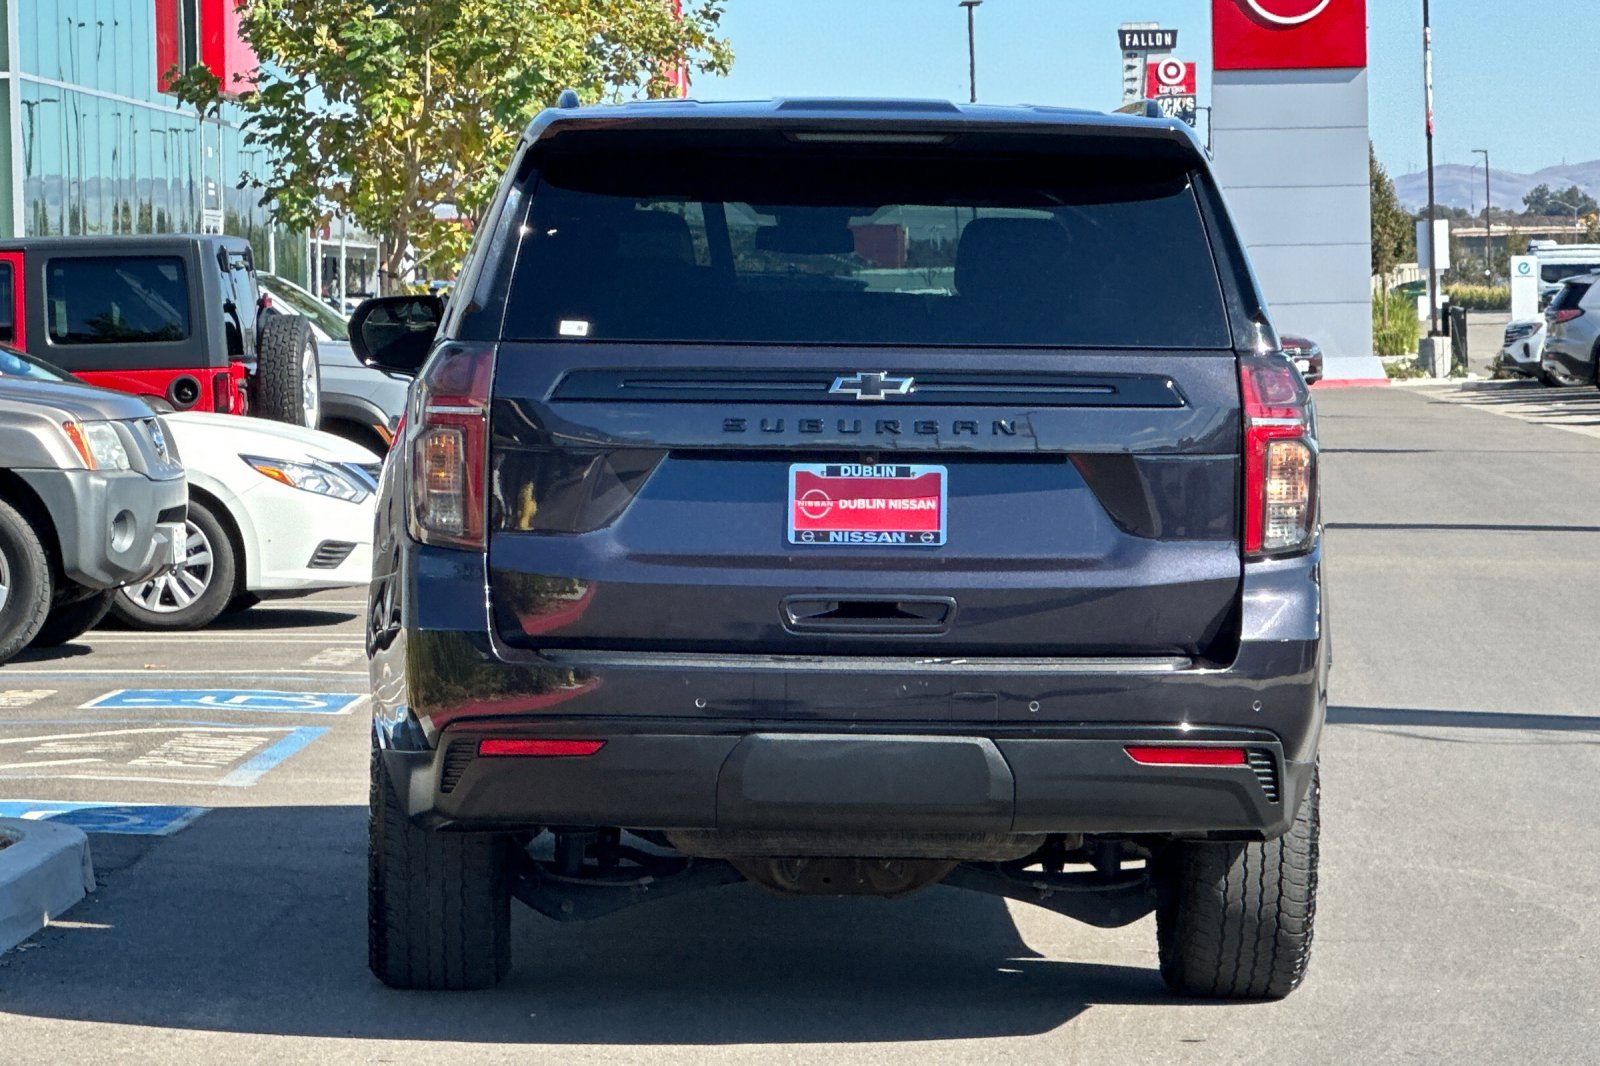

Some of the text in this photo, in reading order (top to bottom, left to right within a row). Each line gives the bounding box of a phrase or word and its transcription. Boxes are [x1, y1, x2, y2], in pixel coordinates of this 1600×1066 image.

[1125, 33, 1172, 46] FALLON
[722, 418, 1017, 435] SUBURBAN
[840, 465, 896, 477] DUBLIN
[839, 498, 936, 510] DUBLIN NISSAN
[829, 531, 906, 543] NISSAN
